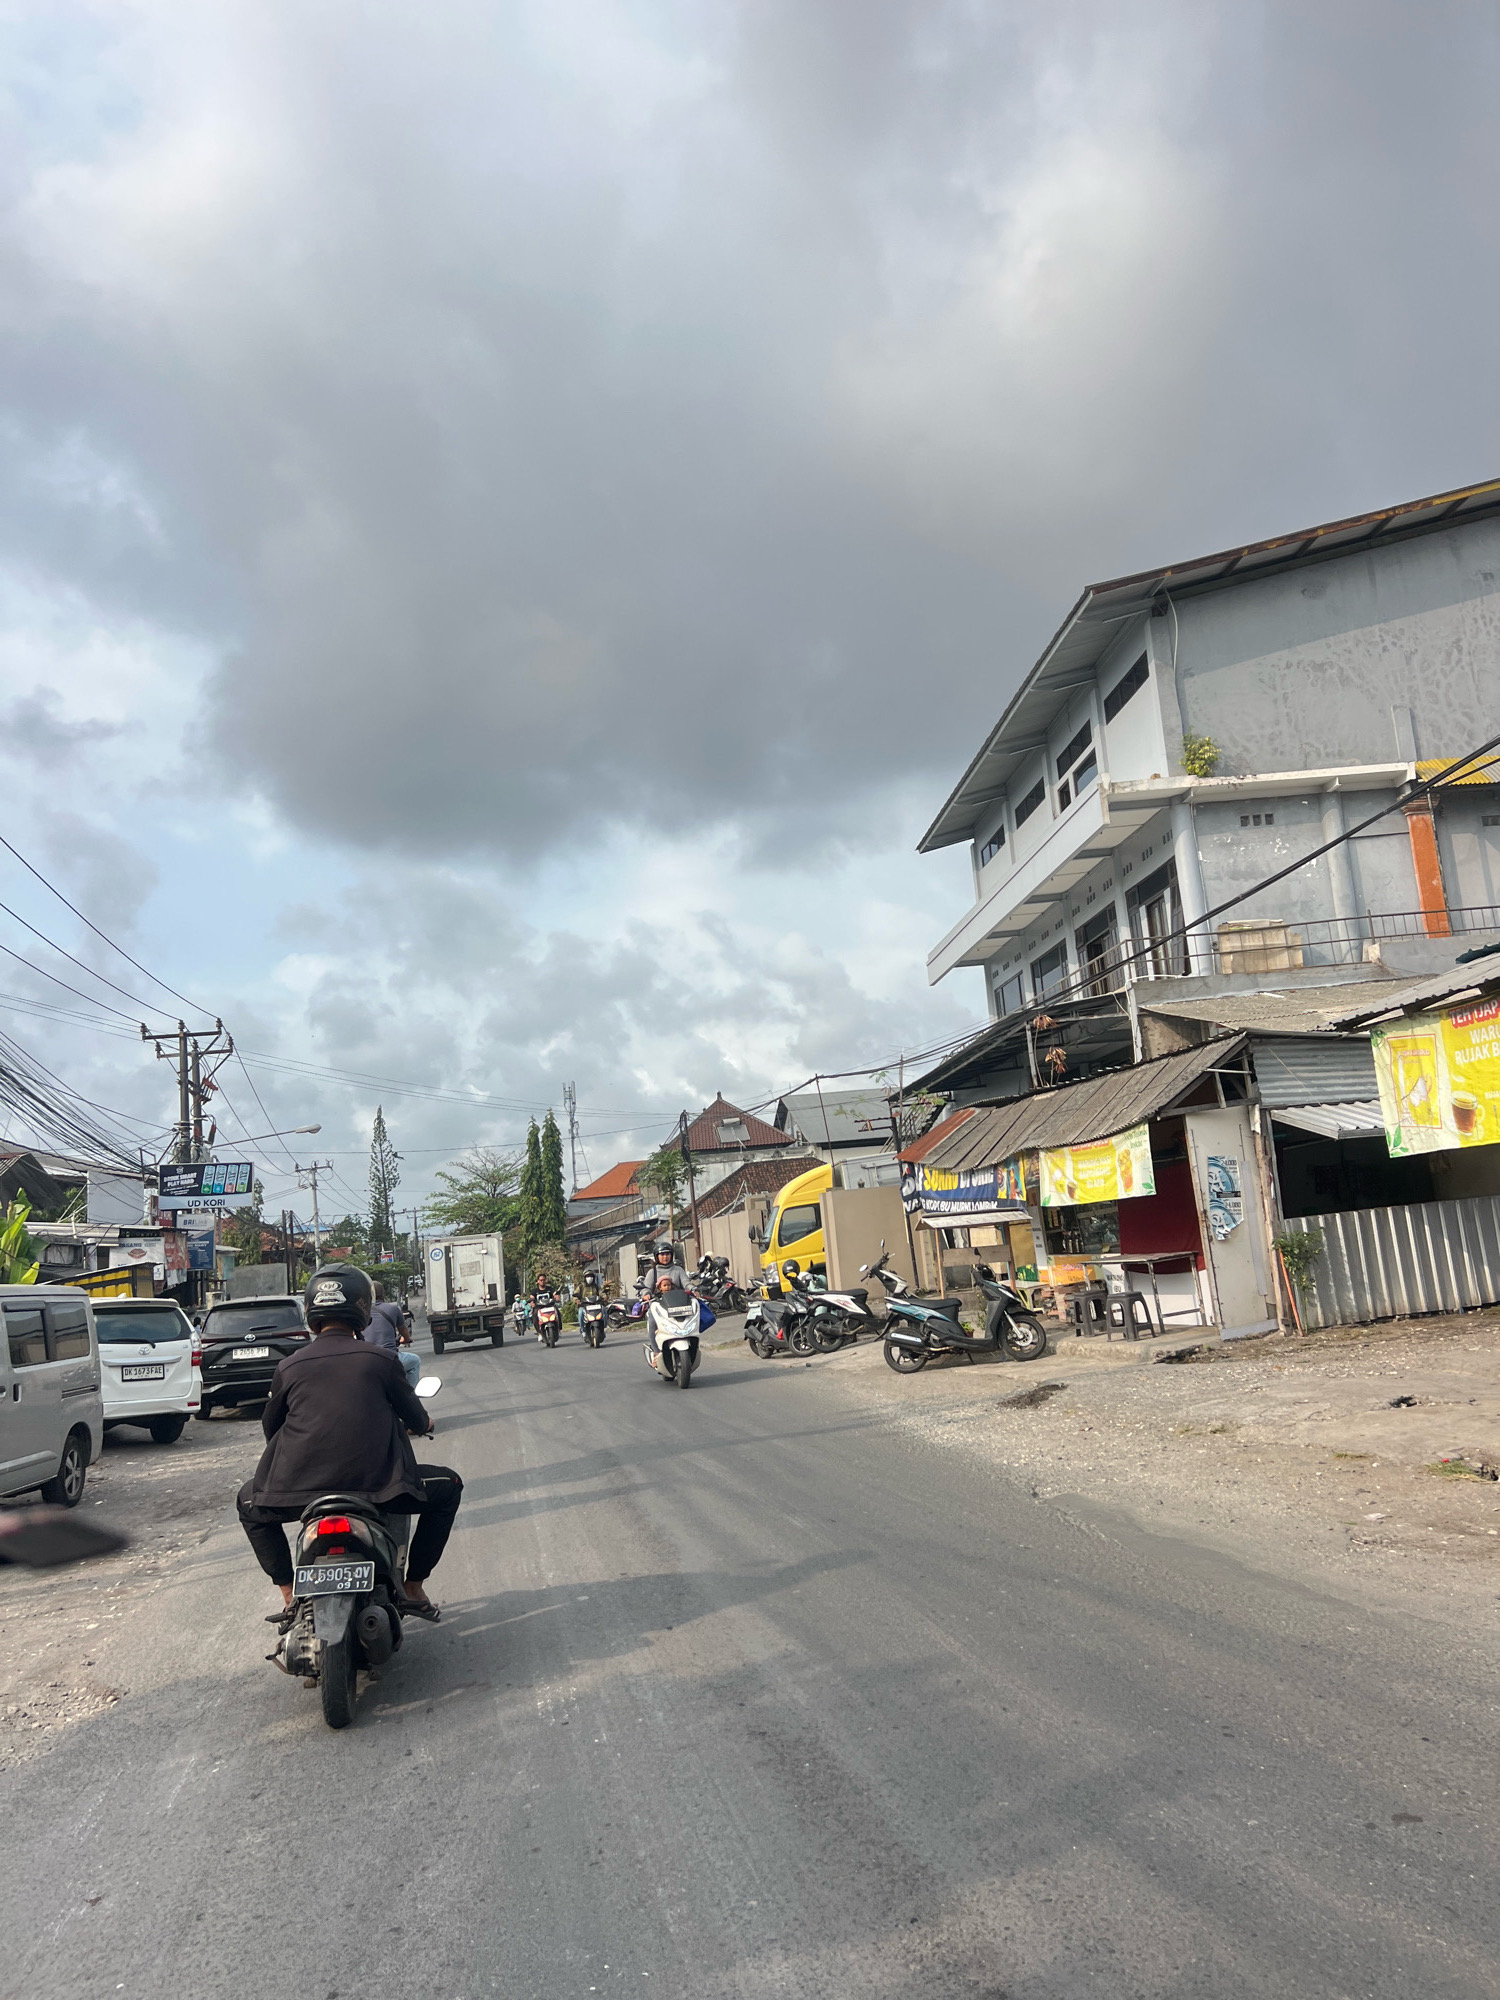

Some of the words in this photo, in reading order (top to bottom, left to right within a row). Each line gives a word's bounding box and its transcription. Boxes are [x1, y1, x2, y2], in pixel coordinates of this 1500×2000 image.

[1449, 1007, 1472, 1025] TEH
[1454, 1043, 1491, 1066] RUJAK
[187, 1200, 201, 1208] UD
[203, 1198, 226, 1207] KORI
[124, 1368, 133, 1376] DK
[134, 1367, 150, 1376] 1673
[150, 1366, 162, 1374] FAE
[298, 1569, 314, 1583] DK
[318, 1566, 352, 1583] 5905
[356, 1581, 368, 1589] 17
